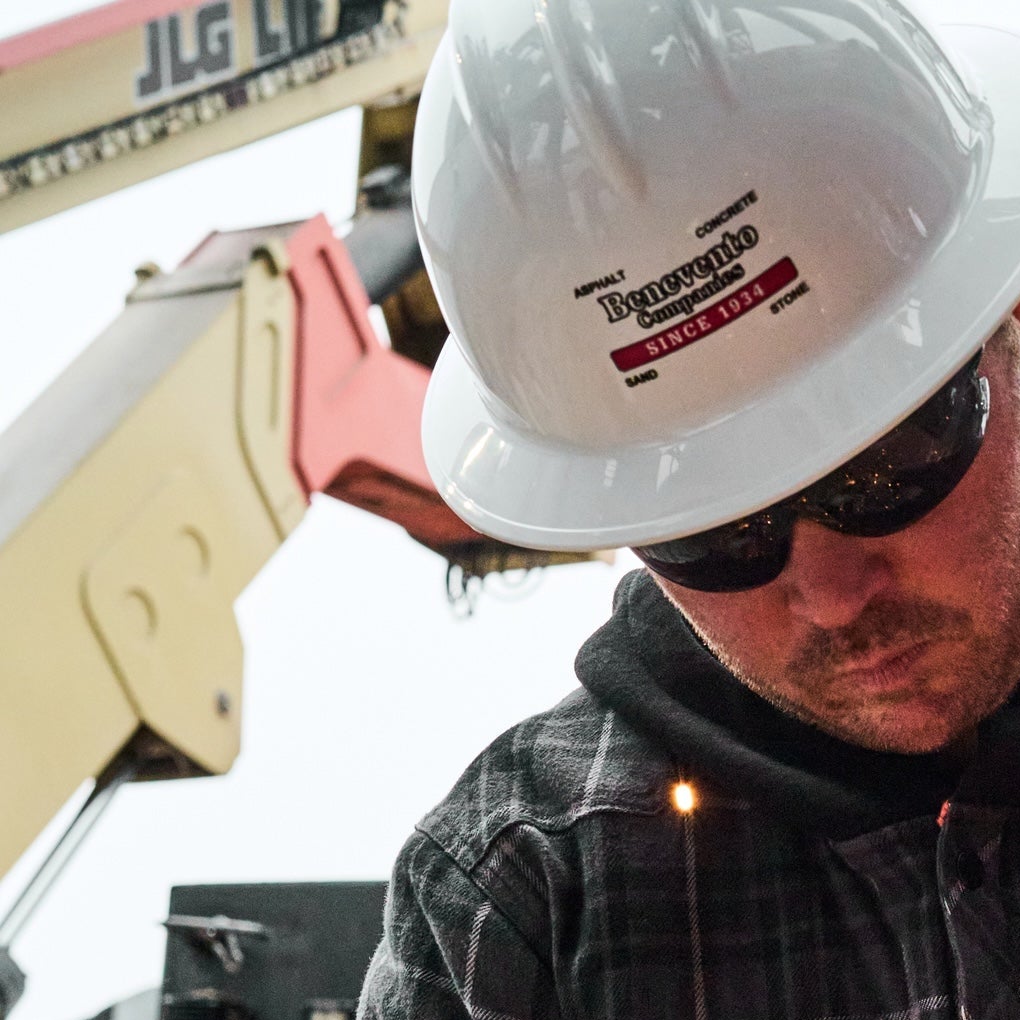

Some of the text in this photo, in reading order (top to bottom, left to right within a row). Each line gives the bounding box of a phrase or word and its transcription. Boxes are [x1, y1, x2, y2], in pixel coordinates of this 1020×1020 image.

[134, 0, 235, 100] JLG
[695, 189, 758, 239] CONCRETE
[573, 270, 626, 299] ASPHALT
[597, 225, 759, 323] Benevento
[637, 263, 745, 328] Companies
[770, 281, 810, 315] STONE
[645, 283, 765, 356] SINCE 1934
[625, 369, 658, 388] SAND
